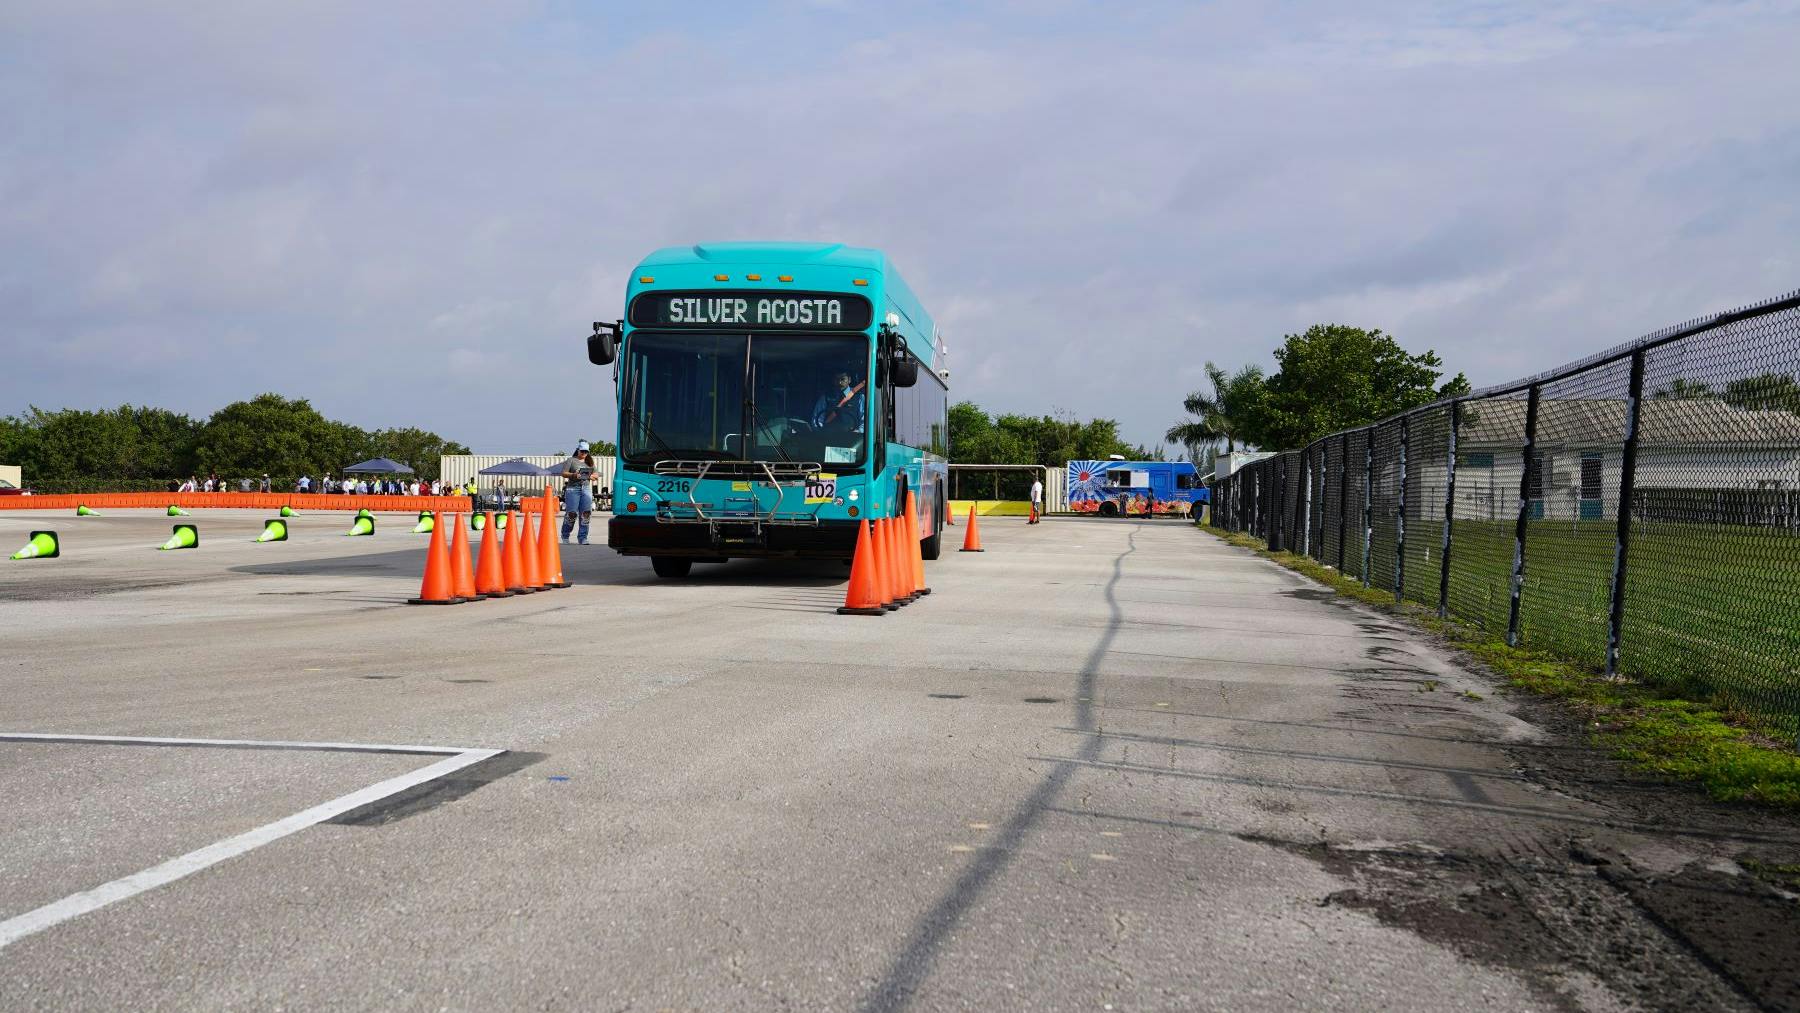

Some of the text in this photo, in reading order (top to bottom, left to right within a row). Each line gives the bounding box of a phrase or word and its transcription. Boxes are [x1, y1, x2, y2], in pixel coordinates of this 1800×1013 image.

[669, 298, 842, 324] SILVER ACOSTA
[657, 480, 690, 493] 2216
[806, 483, 834, 498] 102
